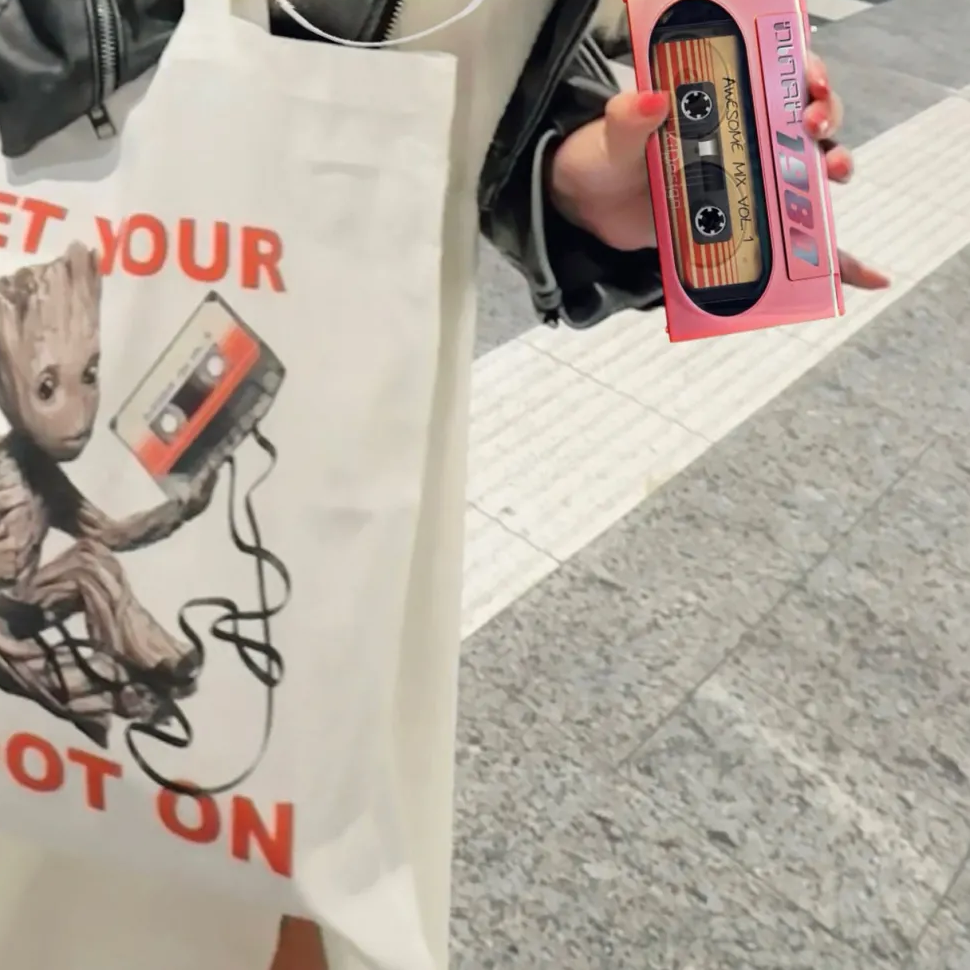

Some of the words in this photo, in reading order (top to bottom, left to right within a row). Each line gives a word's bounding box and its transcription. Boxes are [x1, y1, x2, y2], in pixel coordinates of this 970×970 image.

[722, 77, 744, 153] AWESOME
[732, 161, 747, 188] MIX
[776, 130, 819, 267] 1980
[94, 212, 287, 293] YOUR
[156, 779, 294, 878] ON
